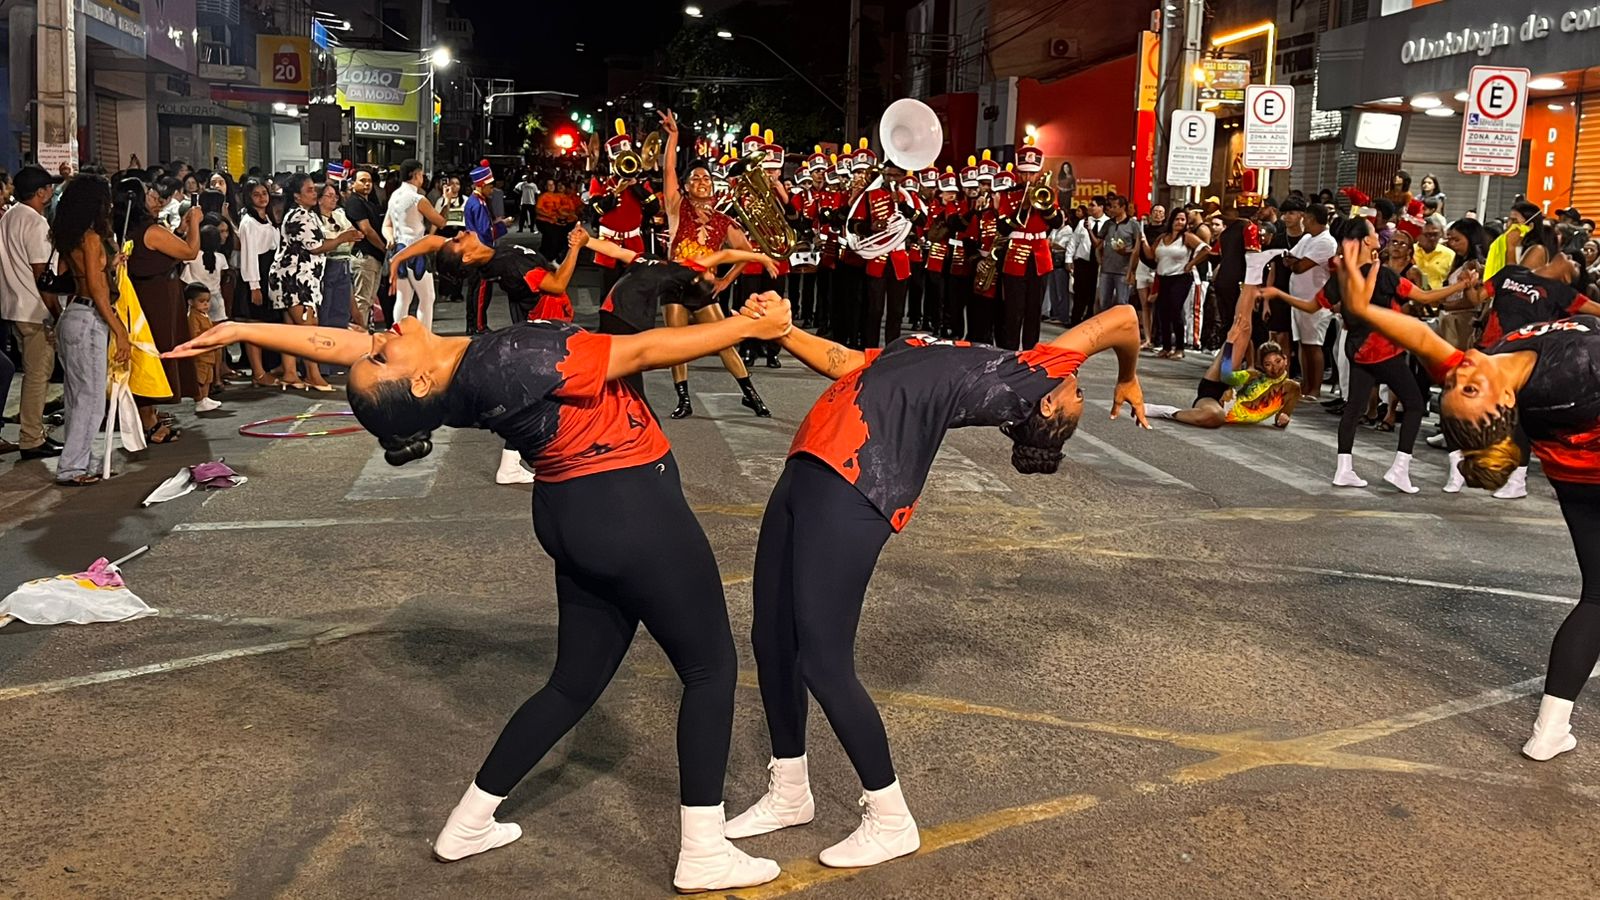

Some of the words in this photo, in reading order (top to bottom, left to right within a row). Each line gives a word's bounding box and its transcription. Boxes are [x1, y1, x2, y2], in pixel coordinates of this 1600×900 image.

[1401, 22, 1512, 64] Odontologia
[1519, 13, 1551, 42] de
[274, 64, 297, 80] 20
[350, 89, 363, 97] DA
[365, 91, 400, 101] MODA
[1489, 86, 1504, 108] E
[157, 103, 217, 115] MOLDURAS
[1264, 98, 1275, 116] E
[354, 121, 370, 132] ÇO
[371, 120, 400, 132] ÚNICO
[1187, 121, 1198, 138] E
[1494, 133, 1514, 141] AZUL
[1076, 180, 1117, 197] mais
